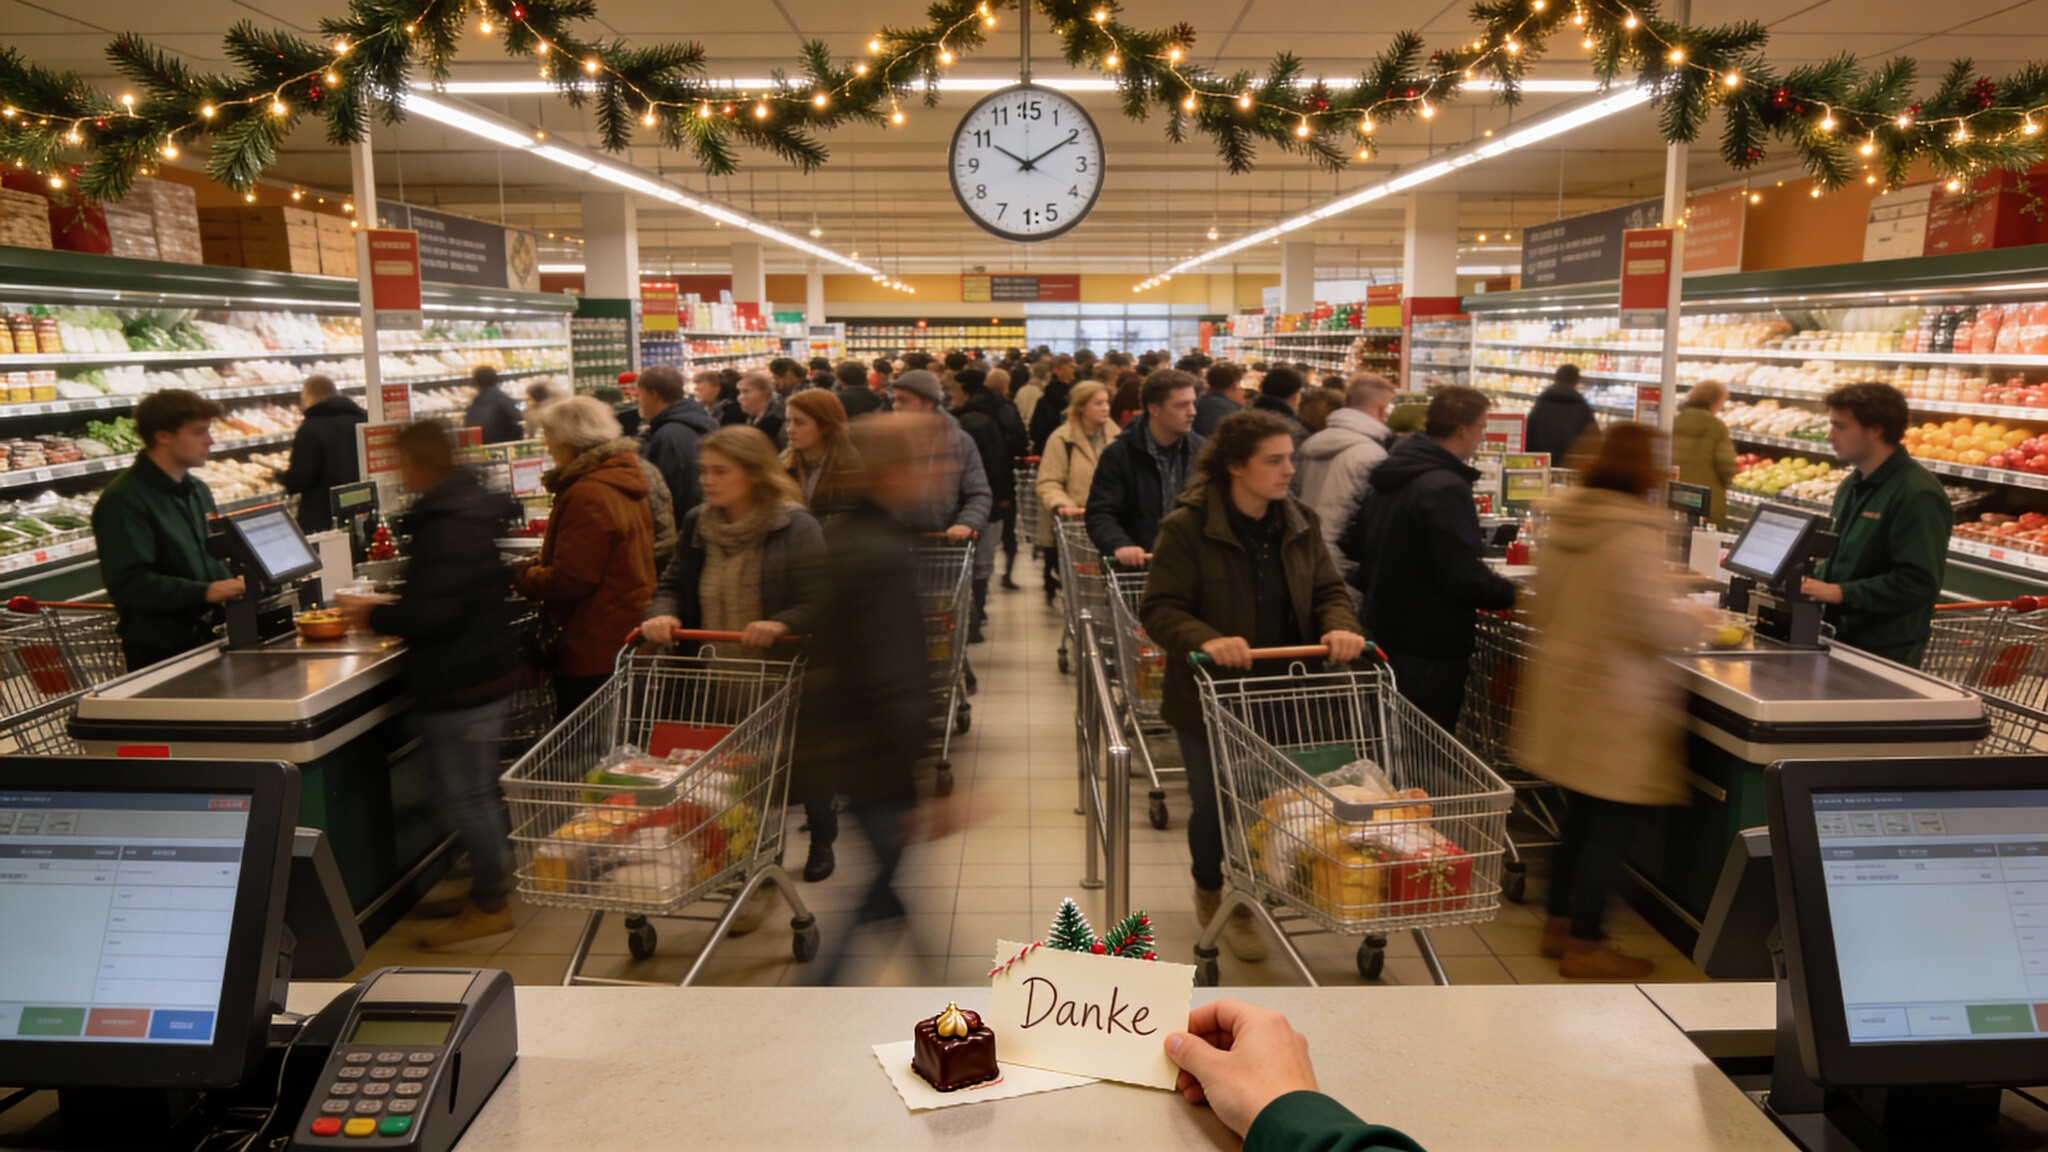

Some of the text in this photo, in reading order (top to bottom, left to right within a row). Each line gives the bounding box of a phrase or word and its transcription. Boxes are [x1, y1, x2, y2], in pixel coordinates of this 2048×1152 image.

[991, 106, 1008, 126] 11
[1053, 109, 1059, 127] 1
[973, 129, 991, 148] 11
[1068, 128, 1080, 145] 2
[968, 157, 979, 174] 9
[1075, 156, 1088, 173] 3
[976, 183, 987, 199] 8
[1067, 184, 1079, 198] 4
[996, 203, 1008, 221] 7
[1020, 975, 1158, 1036] Danke
